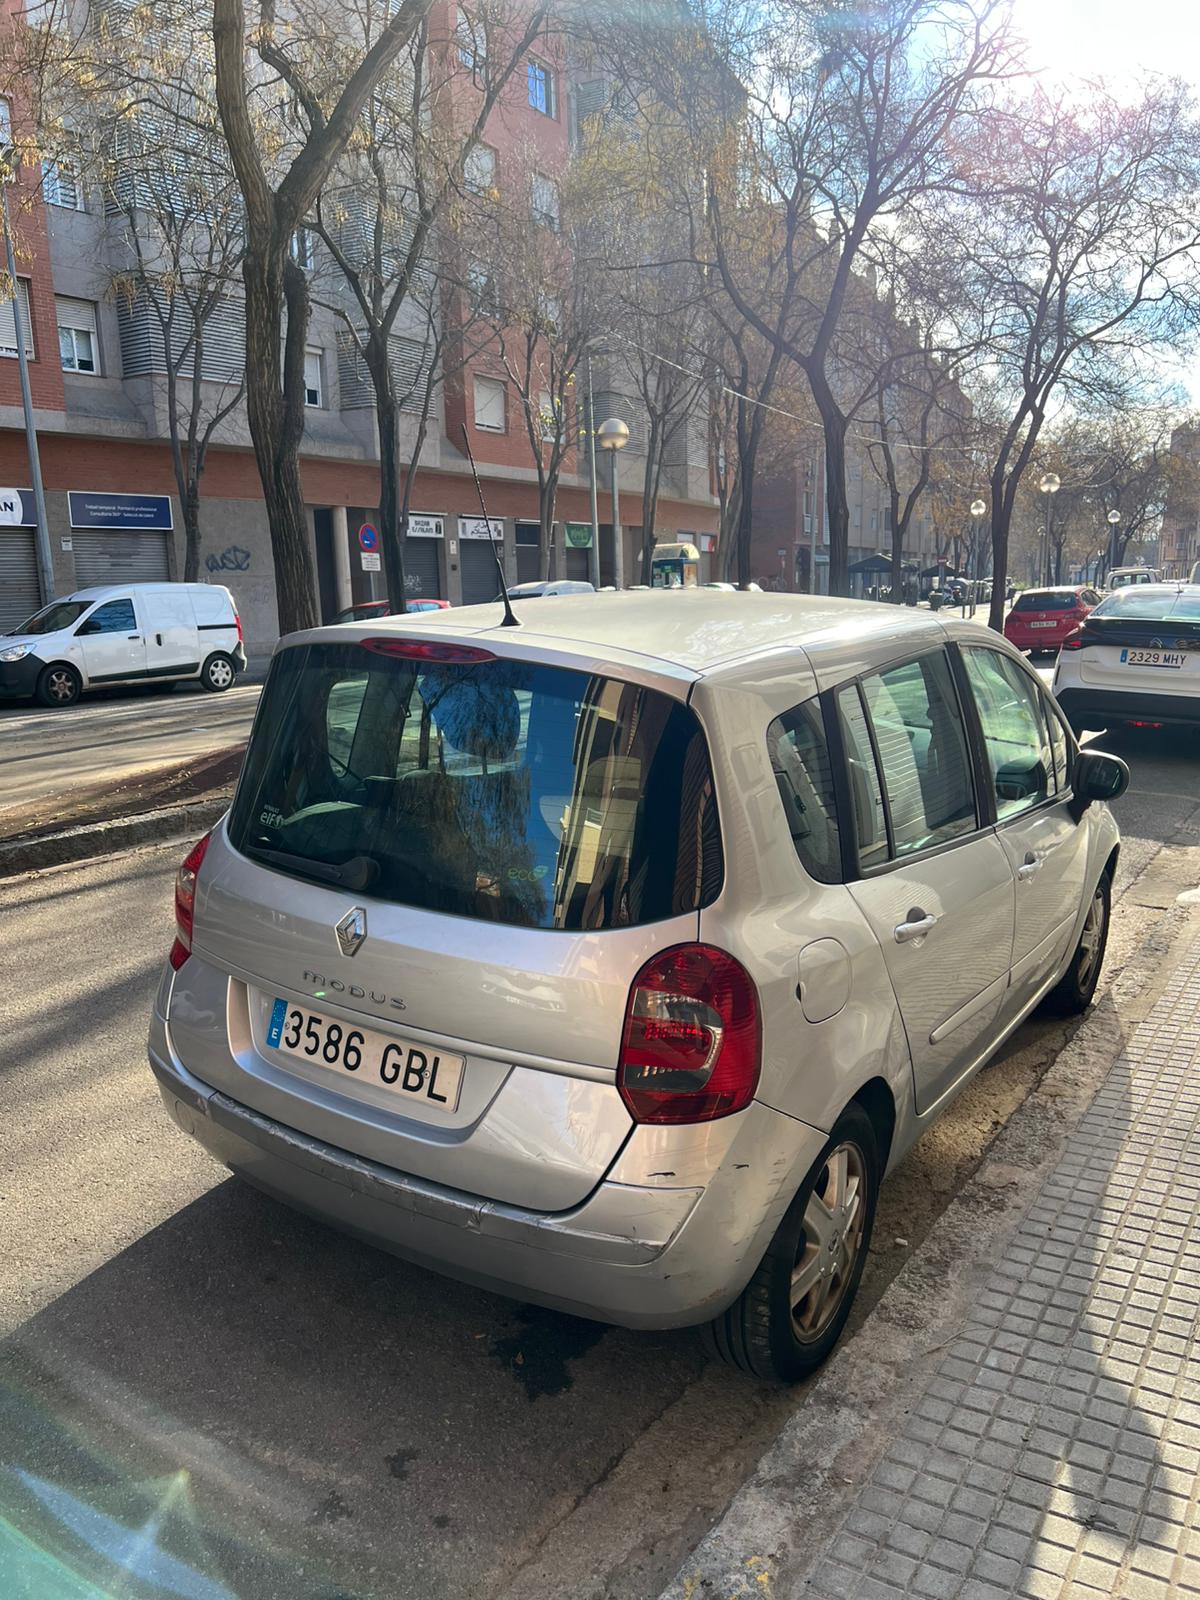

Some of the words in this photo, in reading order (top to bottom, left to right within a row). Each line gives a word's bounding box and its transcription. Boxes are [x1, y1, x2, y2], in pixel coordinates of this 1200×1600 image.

[1129, 651, 1160, 663] 2329
[1163, 653, 1187, 665] MHY
[271, 1027, 279, 1040] E
[284, 1010, 365, 1072] 3586
[379, 1043, 447, 1103] GBL
